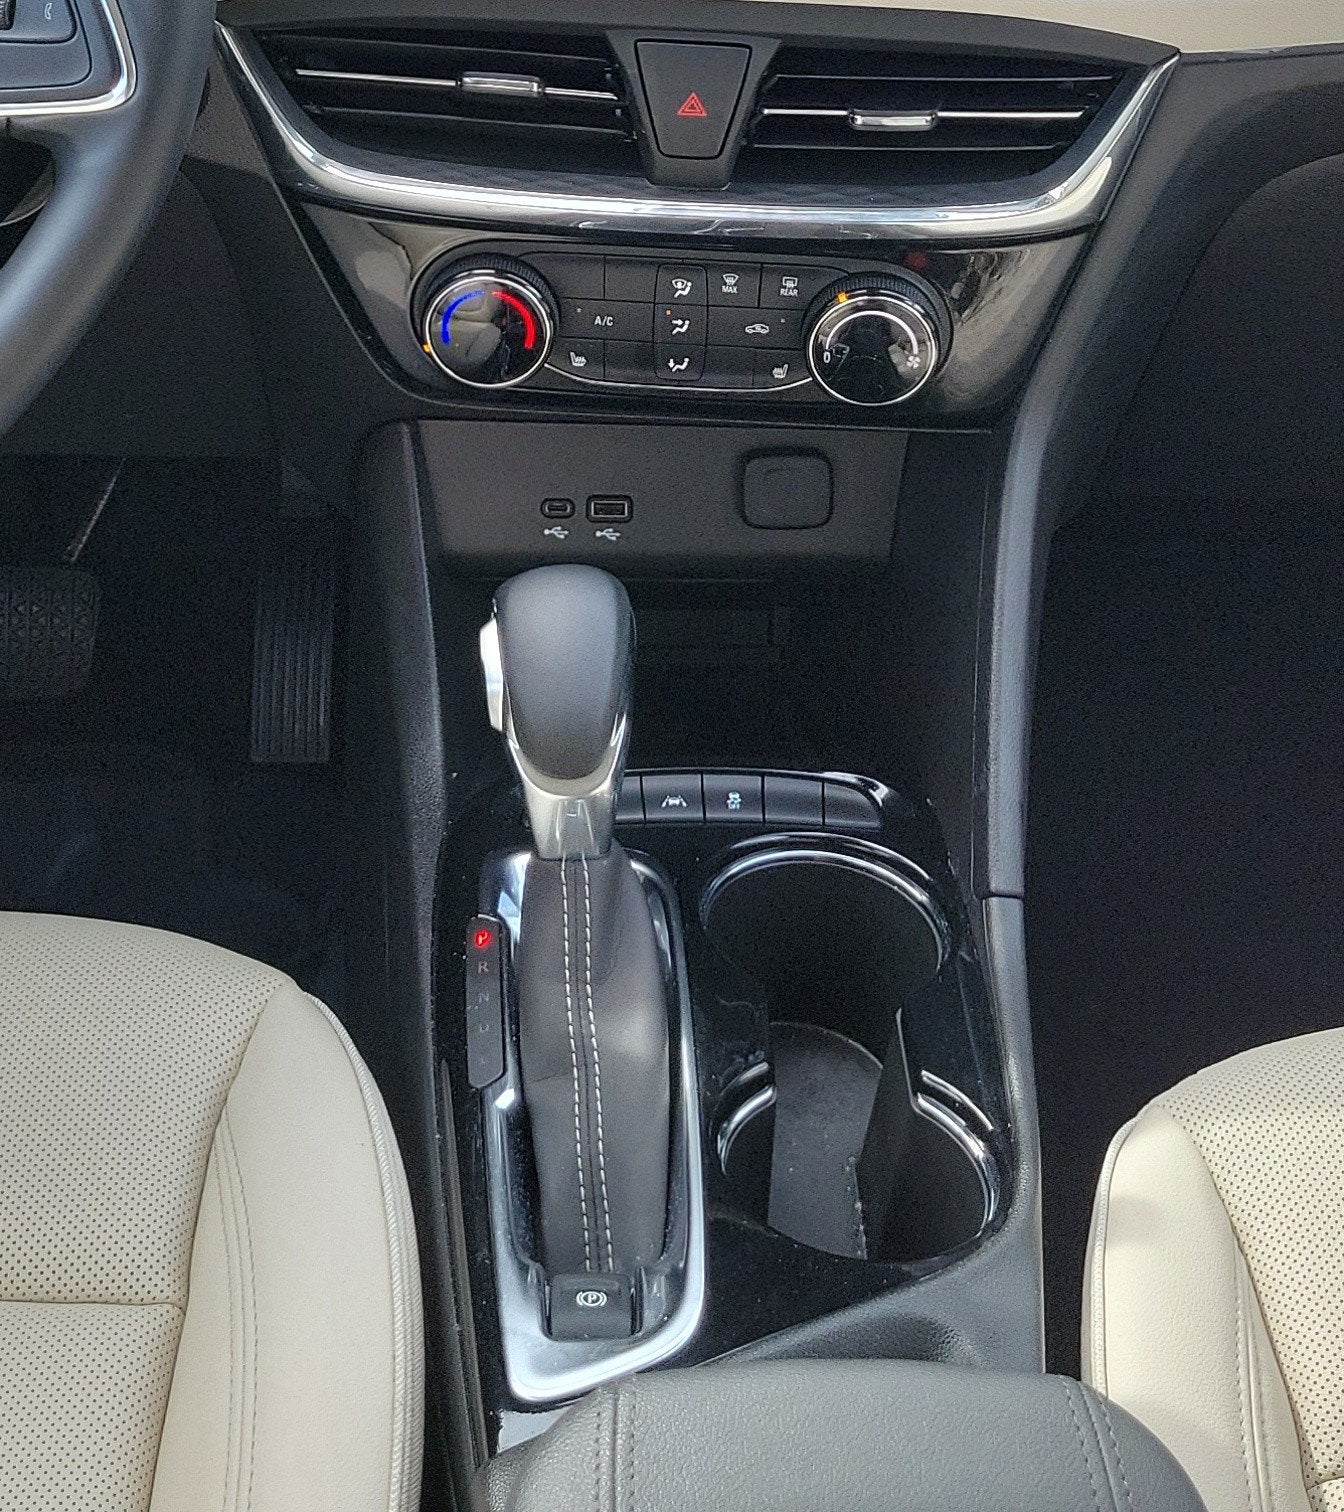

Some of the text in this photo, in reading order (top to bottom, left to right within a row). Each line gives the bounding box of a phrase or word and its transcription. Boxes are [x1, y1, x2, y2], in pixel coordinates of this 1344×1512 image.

[721, 285, 738, 294] MAX
[780, 288, 798, 297] REAR
[594, 315, 613, 327] A/C
[476, 931, 489, 946] P
[478, 960, 489, 974] R
